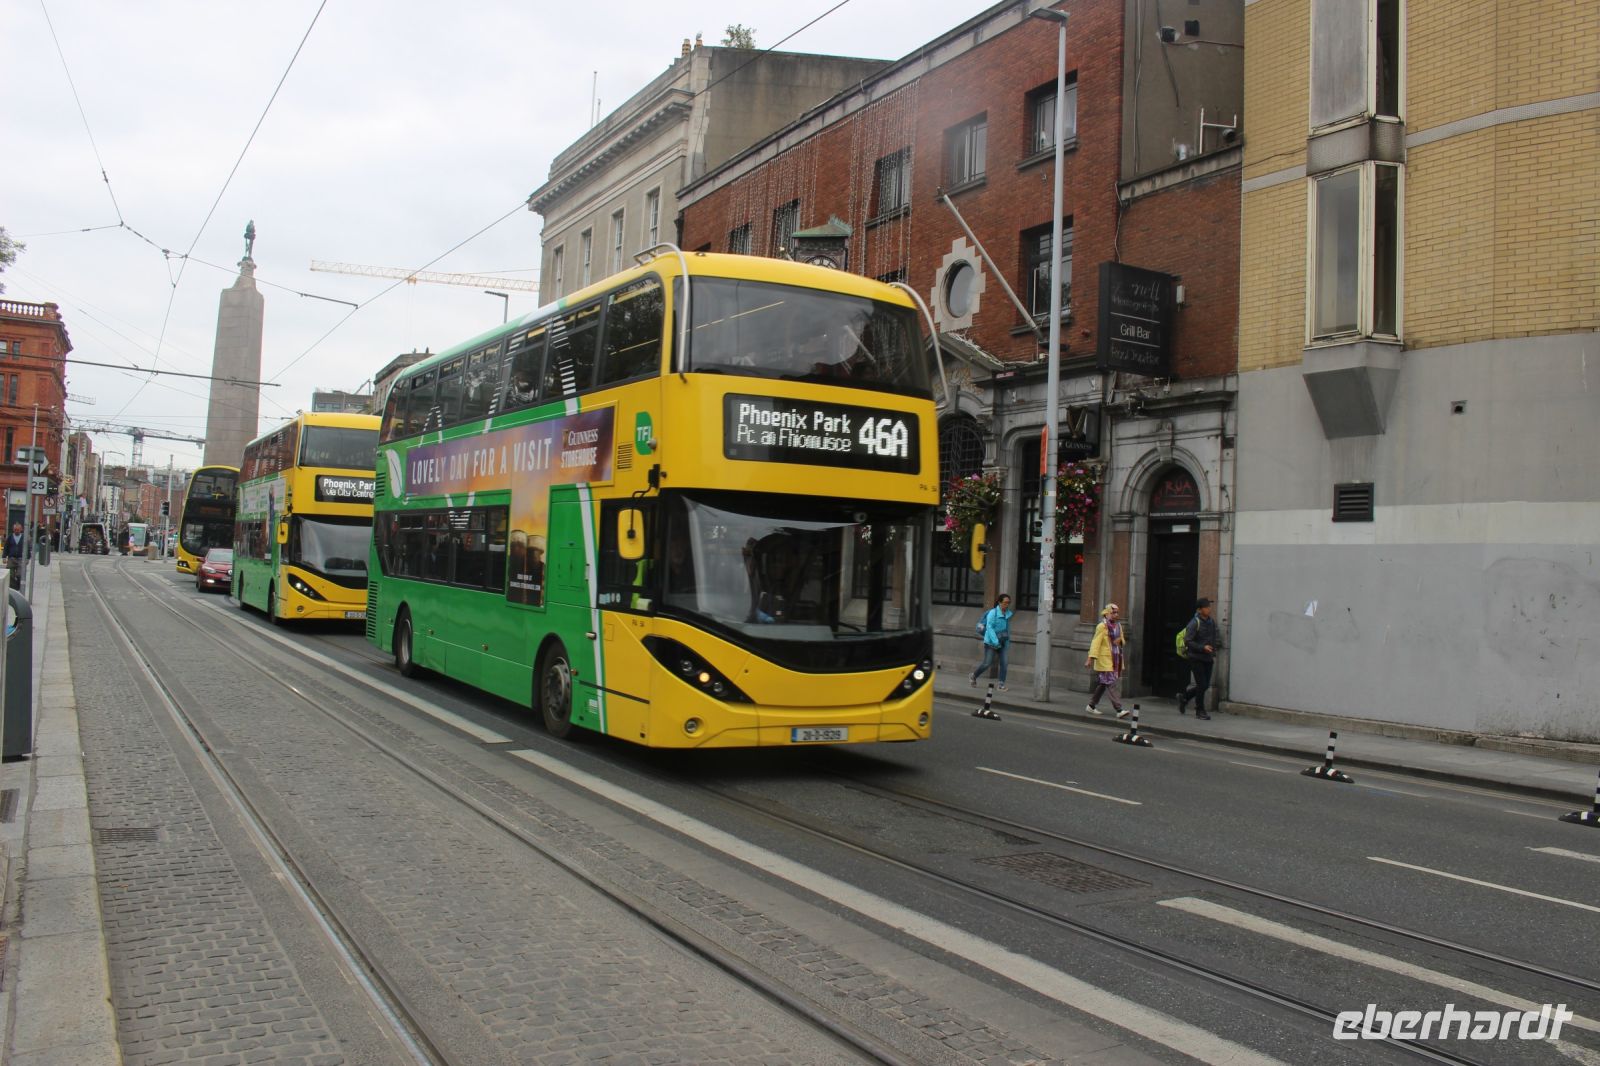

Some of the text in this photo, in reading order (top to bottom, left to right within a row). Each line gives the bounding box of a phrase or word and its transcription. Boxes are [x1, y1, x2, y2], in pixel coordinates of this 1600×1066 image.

[1120, 323, 1151, 339] Grill Bar
[739, 403, 850, 434] Phoenix Park
[568, 428, 599, 446] GUINNESS
[636, 426, 652, 442] TFI
[858, 417, 908, 457] 46A
[412, 438, 552, 485] LOVELY DAY FOR A VISIT
[561, 447, 597, 468] STOREHOUSE
[32, 481, 45, 490] 25
[323, 478, 356, 489] Phoenix
[325, 488, 336, 496] via
[338, 488, 350, 497] City
